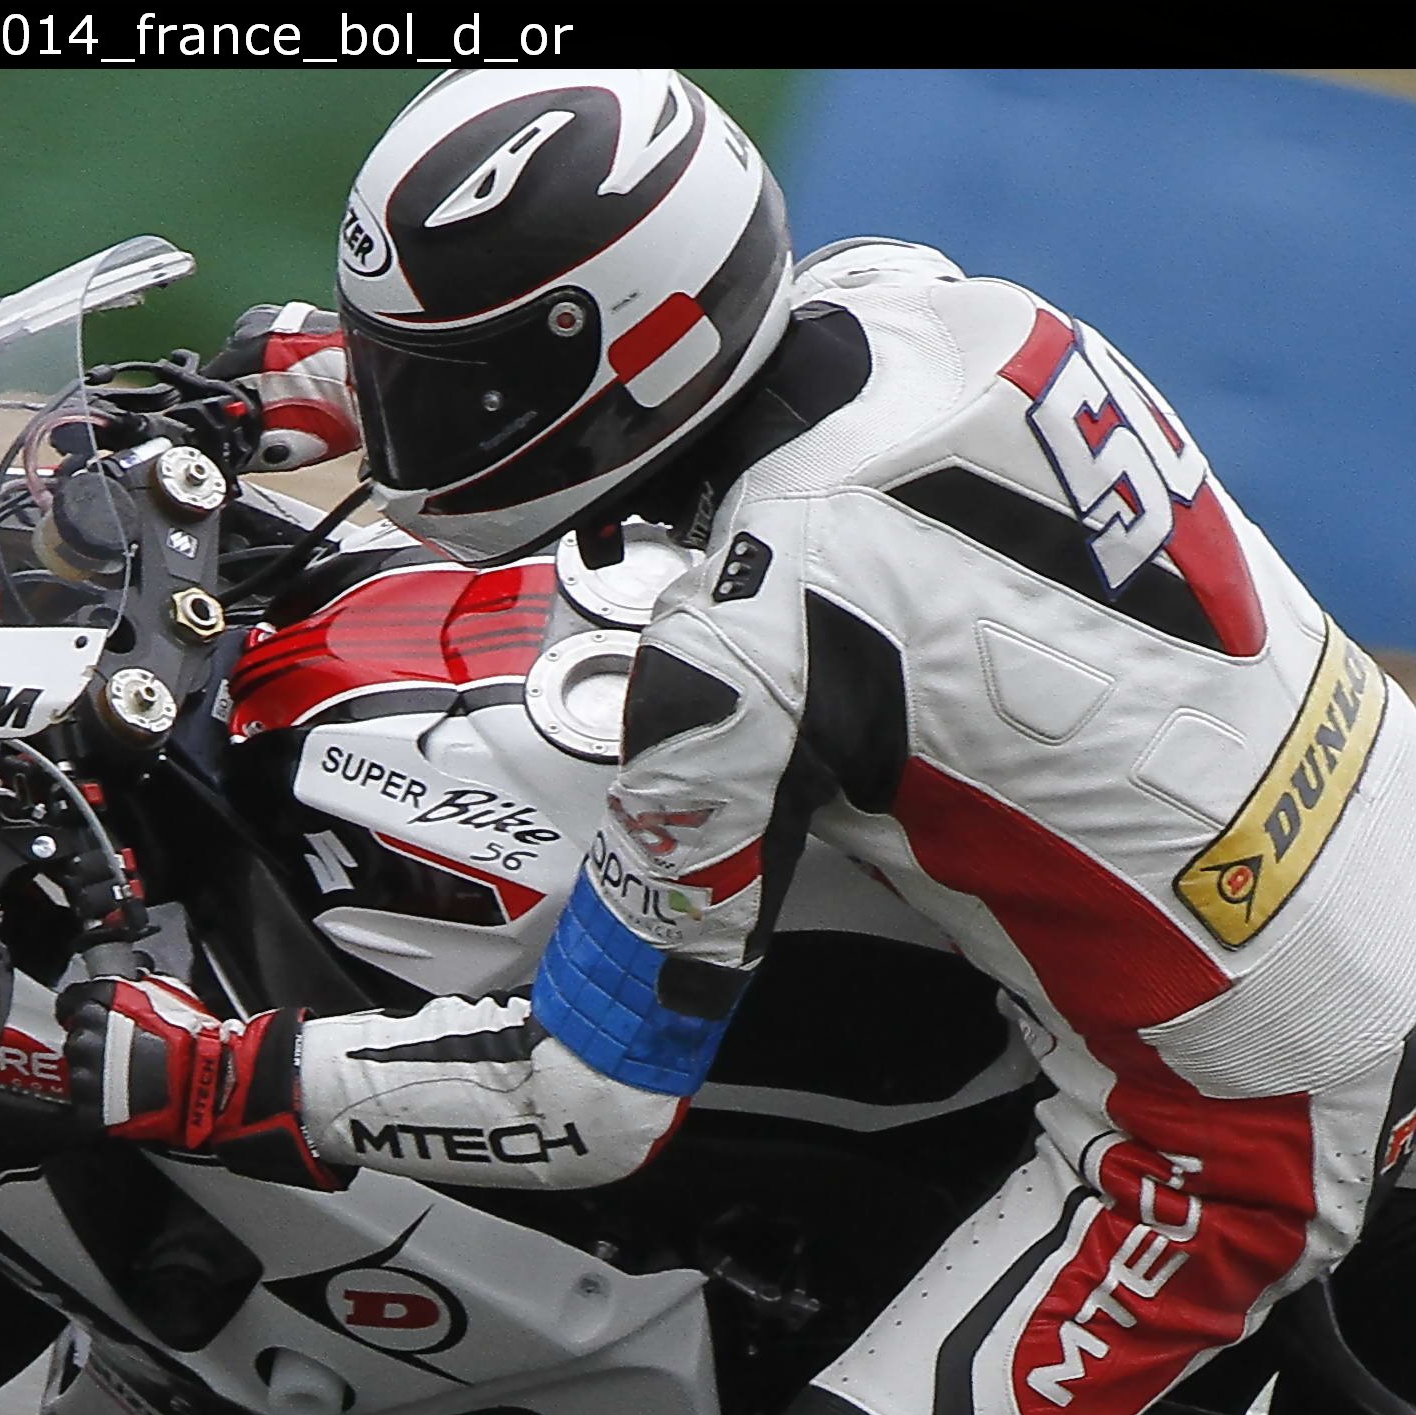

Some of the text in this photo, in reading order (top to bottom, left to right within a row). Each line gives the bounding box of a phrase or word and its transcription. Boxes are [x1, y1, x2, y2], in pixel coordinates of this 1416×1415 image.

[343, 207, 375, 267] ZER
[1263, 650, 1369, 864] DUNLO
[321, 746, 562, 846] SUPER Bike
[469, 842, 539, 872] 56
[348, 1118, 589, 1164] MTECH
